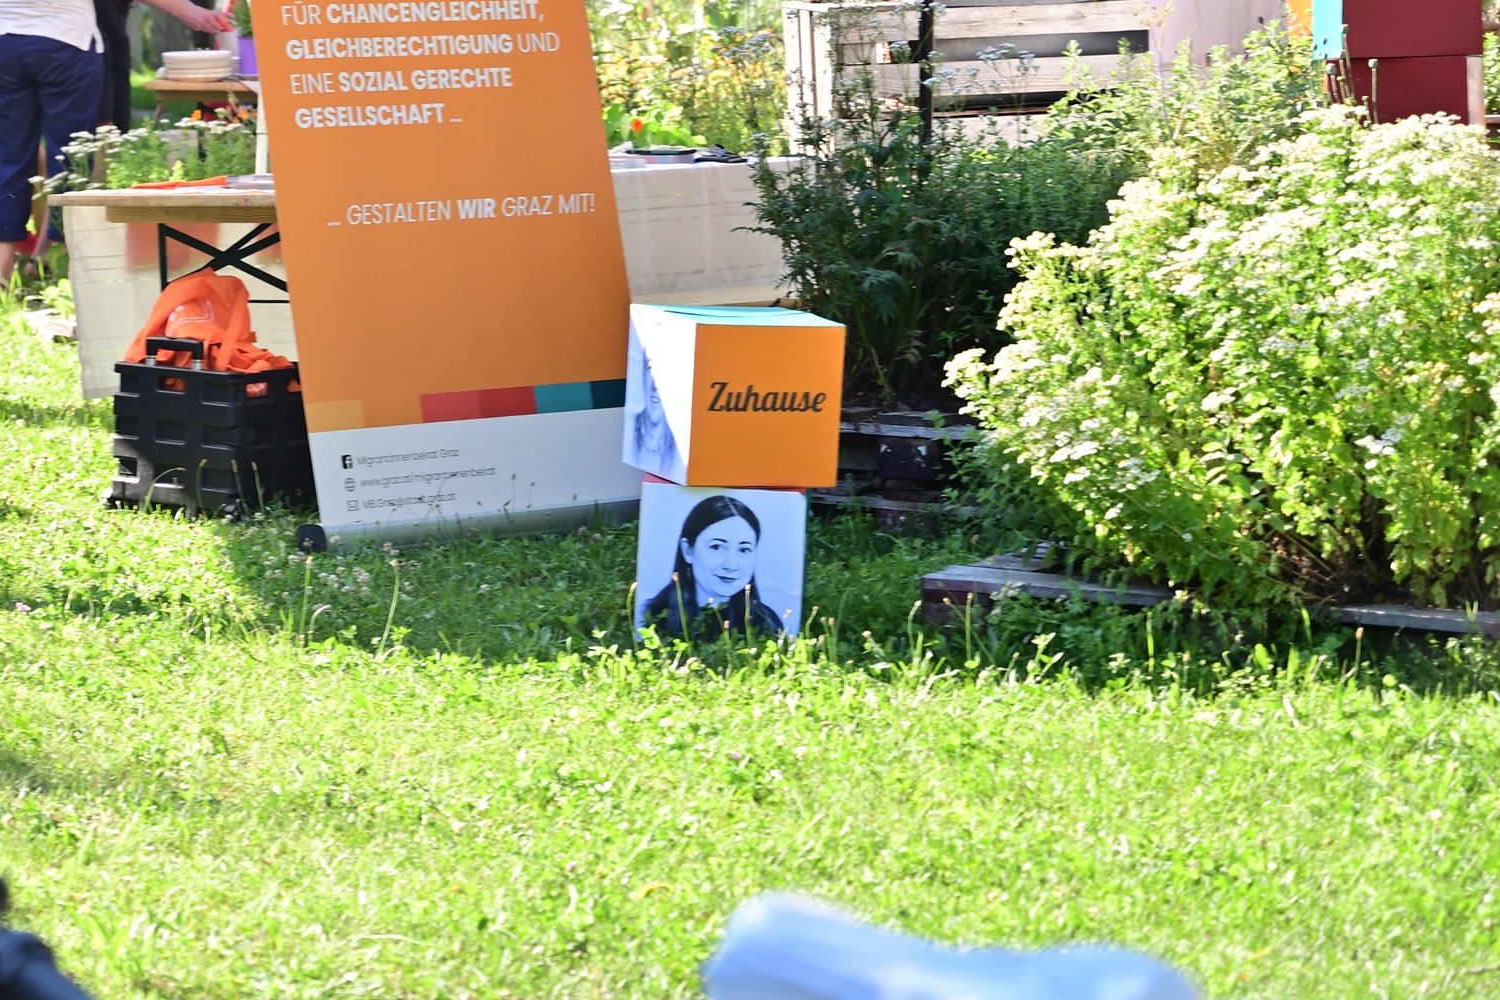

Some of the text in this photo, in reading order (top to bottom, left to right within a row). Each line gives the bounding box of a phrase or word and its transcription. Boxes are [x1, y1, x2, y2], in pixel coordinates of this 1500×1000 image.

[281, 0, 544, 26] FÜR CHANCENGLEICHHEIT,
[285, 32, 560, 60] GLEICHBERECHTIGUNG UND
[290, 67, 513, 95] EINE SOZIAL GERECHTE
[294, 103, 445, 129] GESELLSCHAFT
[346, 200, 451, 226] GESTALTEN
[456, 198, 497, 220] WIR
[501, 195, 553, 218] GRAZ
[557, 193, 596, 214] MIT!
[707, 381, 827, 414] Zuhause
